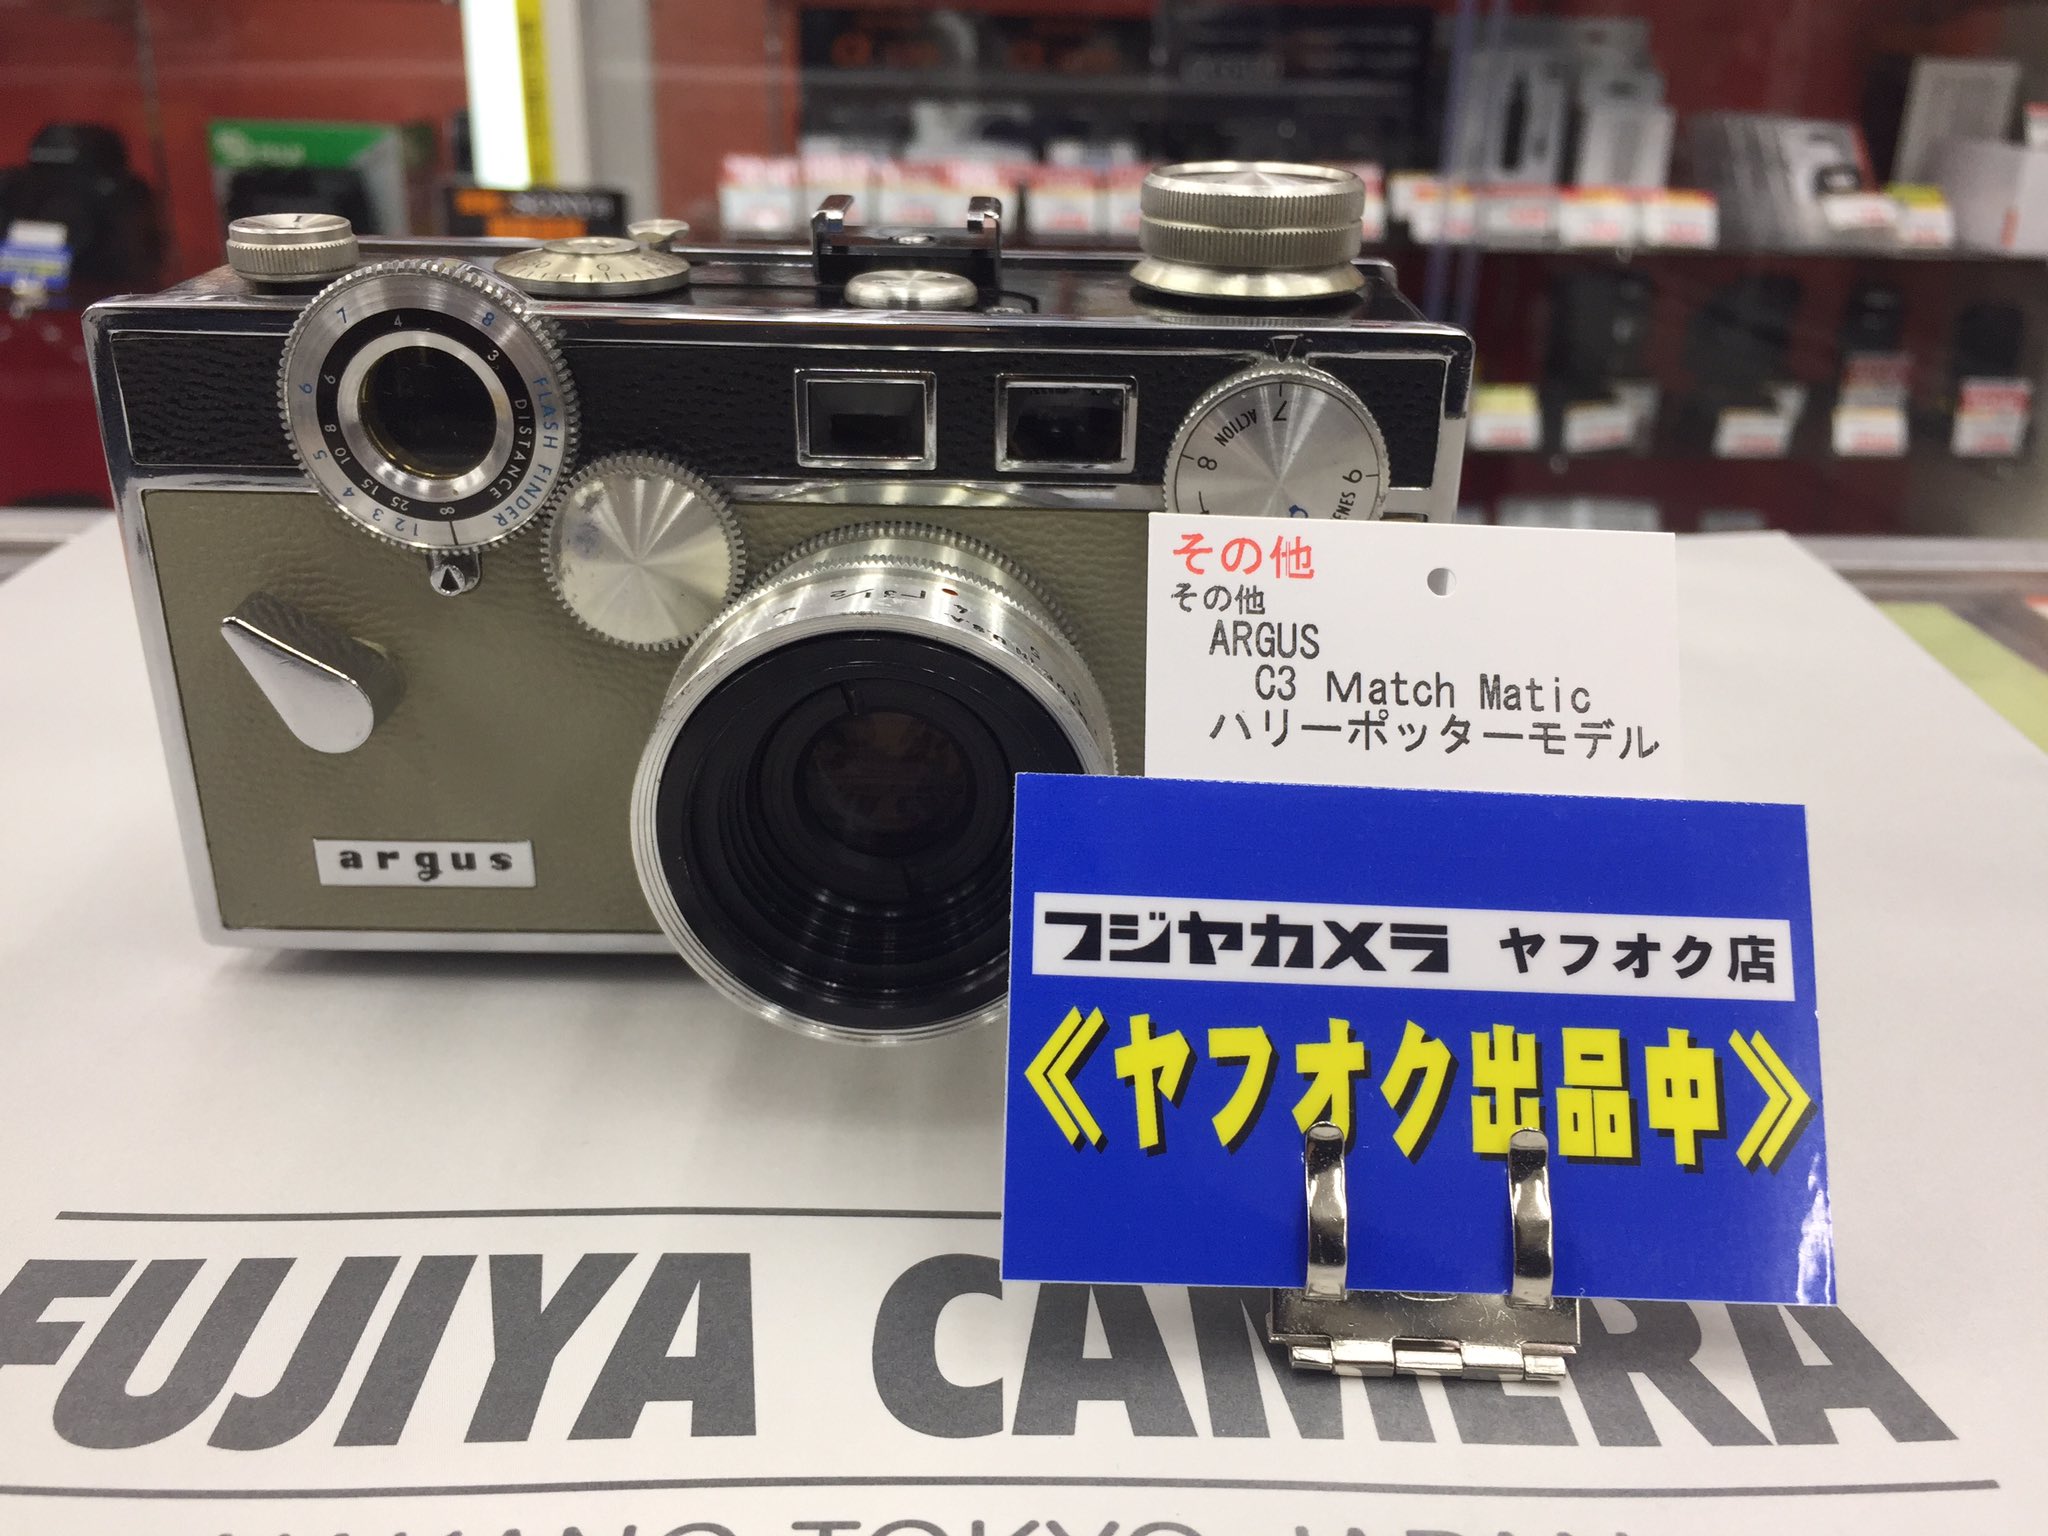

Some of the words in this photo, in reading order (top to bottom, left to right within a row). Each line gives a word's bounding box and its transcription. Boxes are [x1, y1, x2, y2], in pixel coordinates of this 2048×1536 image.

[336, 306, 347, 324] 7
[393, 314, 402, 328] 4
[481, 311, 495, 327] 8
[487, 349, 499, 361] 3
[324, 374, 337, 385] 6
[298, 383, 313, 395] 6
[533, 377, 559, 449] FLASH
[1273, 400, 1287, 422] 7
[324, 423, 337, 433] 8
[1214, 408, 1257, 447] ACTION
[312, 449, 328, 461] 5
[334, 447, 350, 465] 10
[490, 398, 532, 499] DISTANCE
[1197, 456, 1218, 471] 8
[342, 487, 355, 497] 4
[361, 478, 379, 496] 15
[493, 463, 553, 527] FINDER
[390, 496, 411, 511] 25
[372, 508, 384, 521] 3
[395, 517, 405, 532] 2
[1173, 533, 1315, 580] その他
[1170, 582, 1266, 615] その他
[1209, 620, 1320, 660] ARGUS
[1254, 665, 1297, 702] C3
[1327, 671, 1456, 709] Match
[1480, 673, 1591, 714] Matic
[1209, 708, 1661, 761] ハリーポッターモデル
[338, 849, 514, 883] argus
[1044, 909, 1449, 975] フジヤカメラ
[1499, 926, 1777, 985] ヤフオク店
[0, 1252, 757, 1451] FUJIYA
